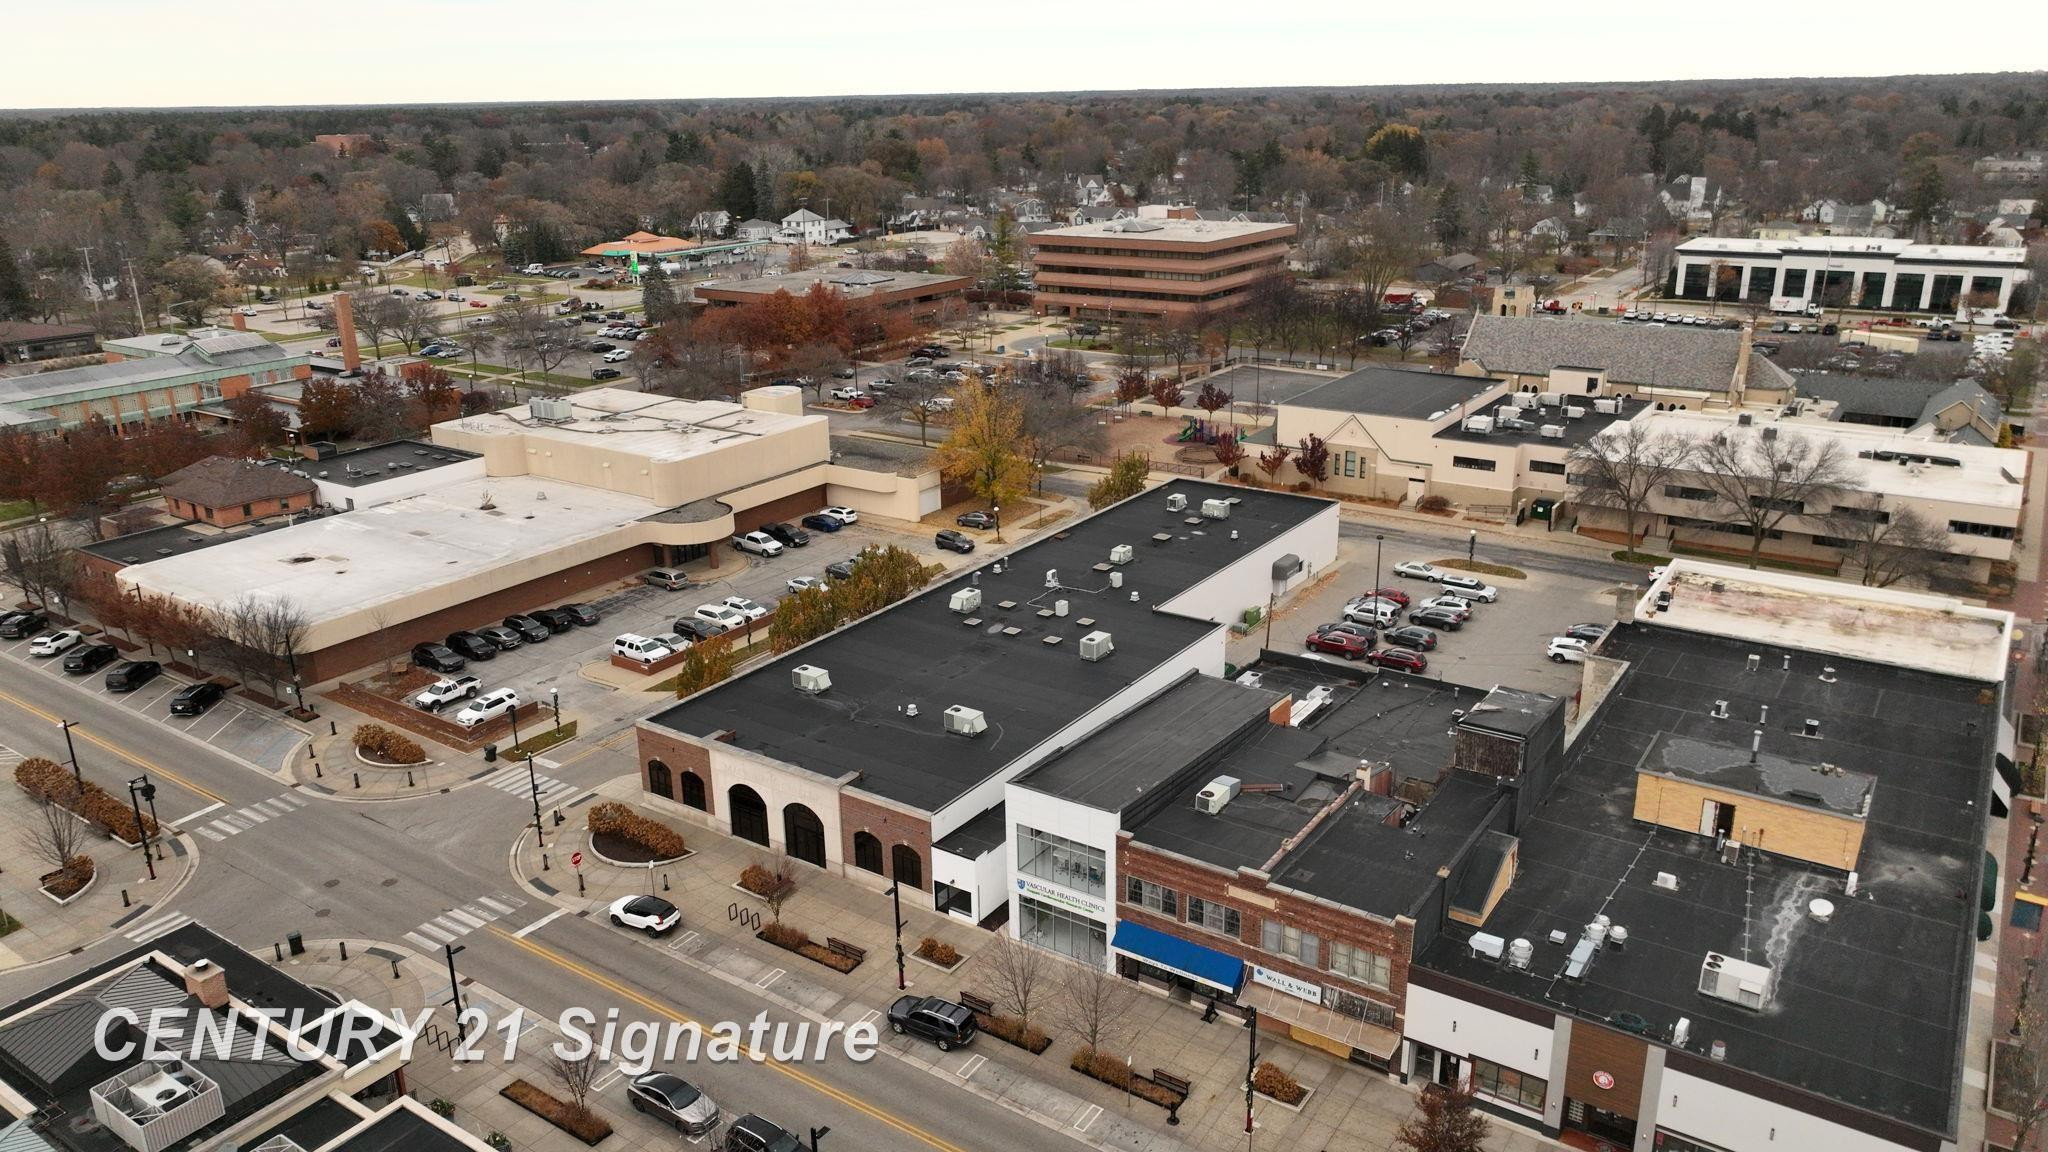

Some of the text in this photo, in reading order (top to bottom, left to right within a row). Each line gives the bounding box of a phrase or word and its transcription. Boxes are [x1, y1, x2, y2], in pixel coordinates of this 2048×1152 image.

[572, 854, 582, 863] STOP
[1025, 881, 1055, 895] VASCULAR
[1056, 892, 1080, 904] HEALTH
[1081, 900, 1105, 912] CLINICS
[1266, 974, 1287, 987] WALL
[1295, 985, 1317, 998] WEBB
